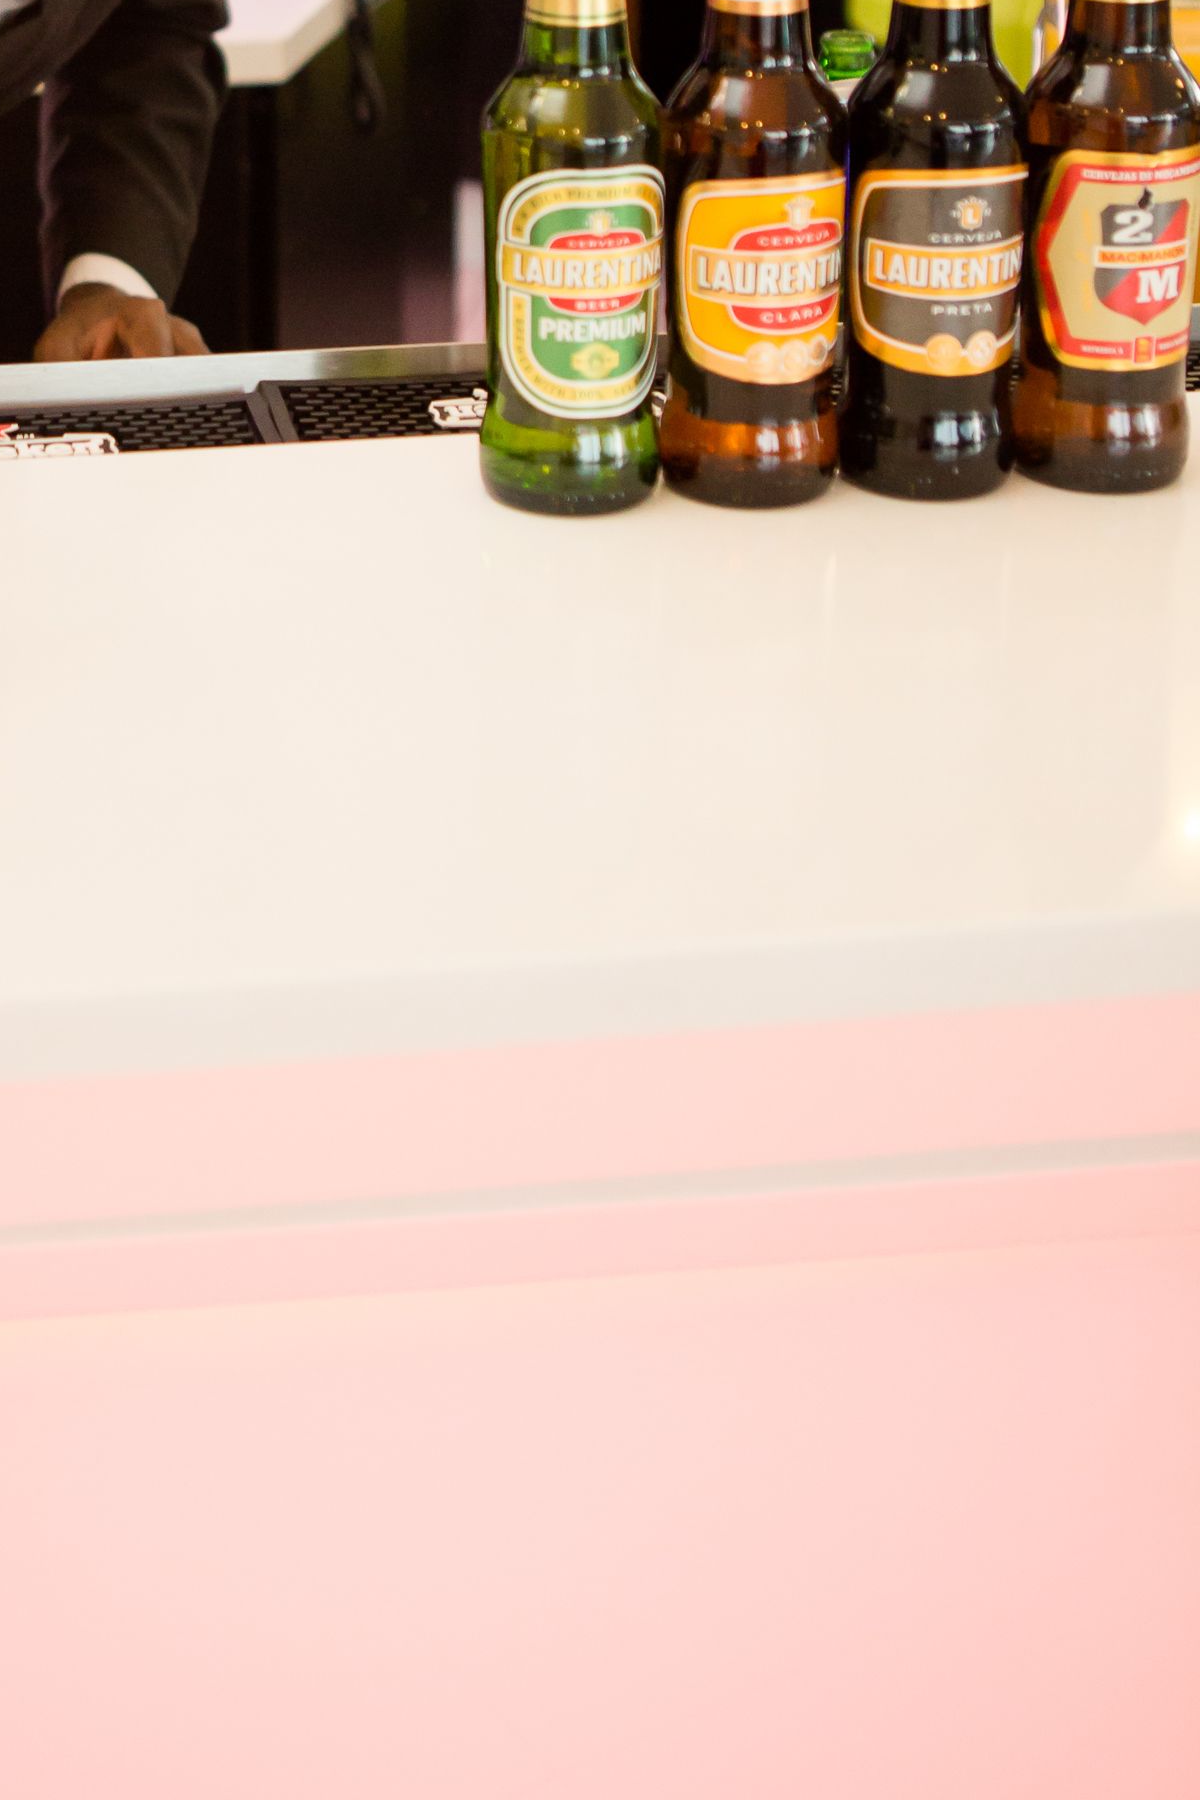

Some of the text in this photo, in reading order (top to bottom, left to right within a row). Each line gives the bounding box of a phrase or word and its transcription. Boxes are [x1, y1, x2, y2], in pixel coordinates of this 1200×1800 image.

[1112, 209, 1154, 244] 2
[568, 238, 631, 248] CERVEJA
[757, 230, 831, 247] CERVEJA
[928, 230, 1002, 244] CERVEJA
[512, 247, 661, 288] LAURENTINA
[1136, 265, 1180, 304] M
[575, 299, 620, 311] BEER
[931, 302, 993, 316] PRETA
[758, 305, 824, 323] CLARA
[538, 311, 646, 343] PREMIUM
